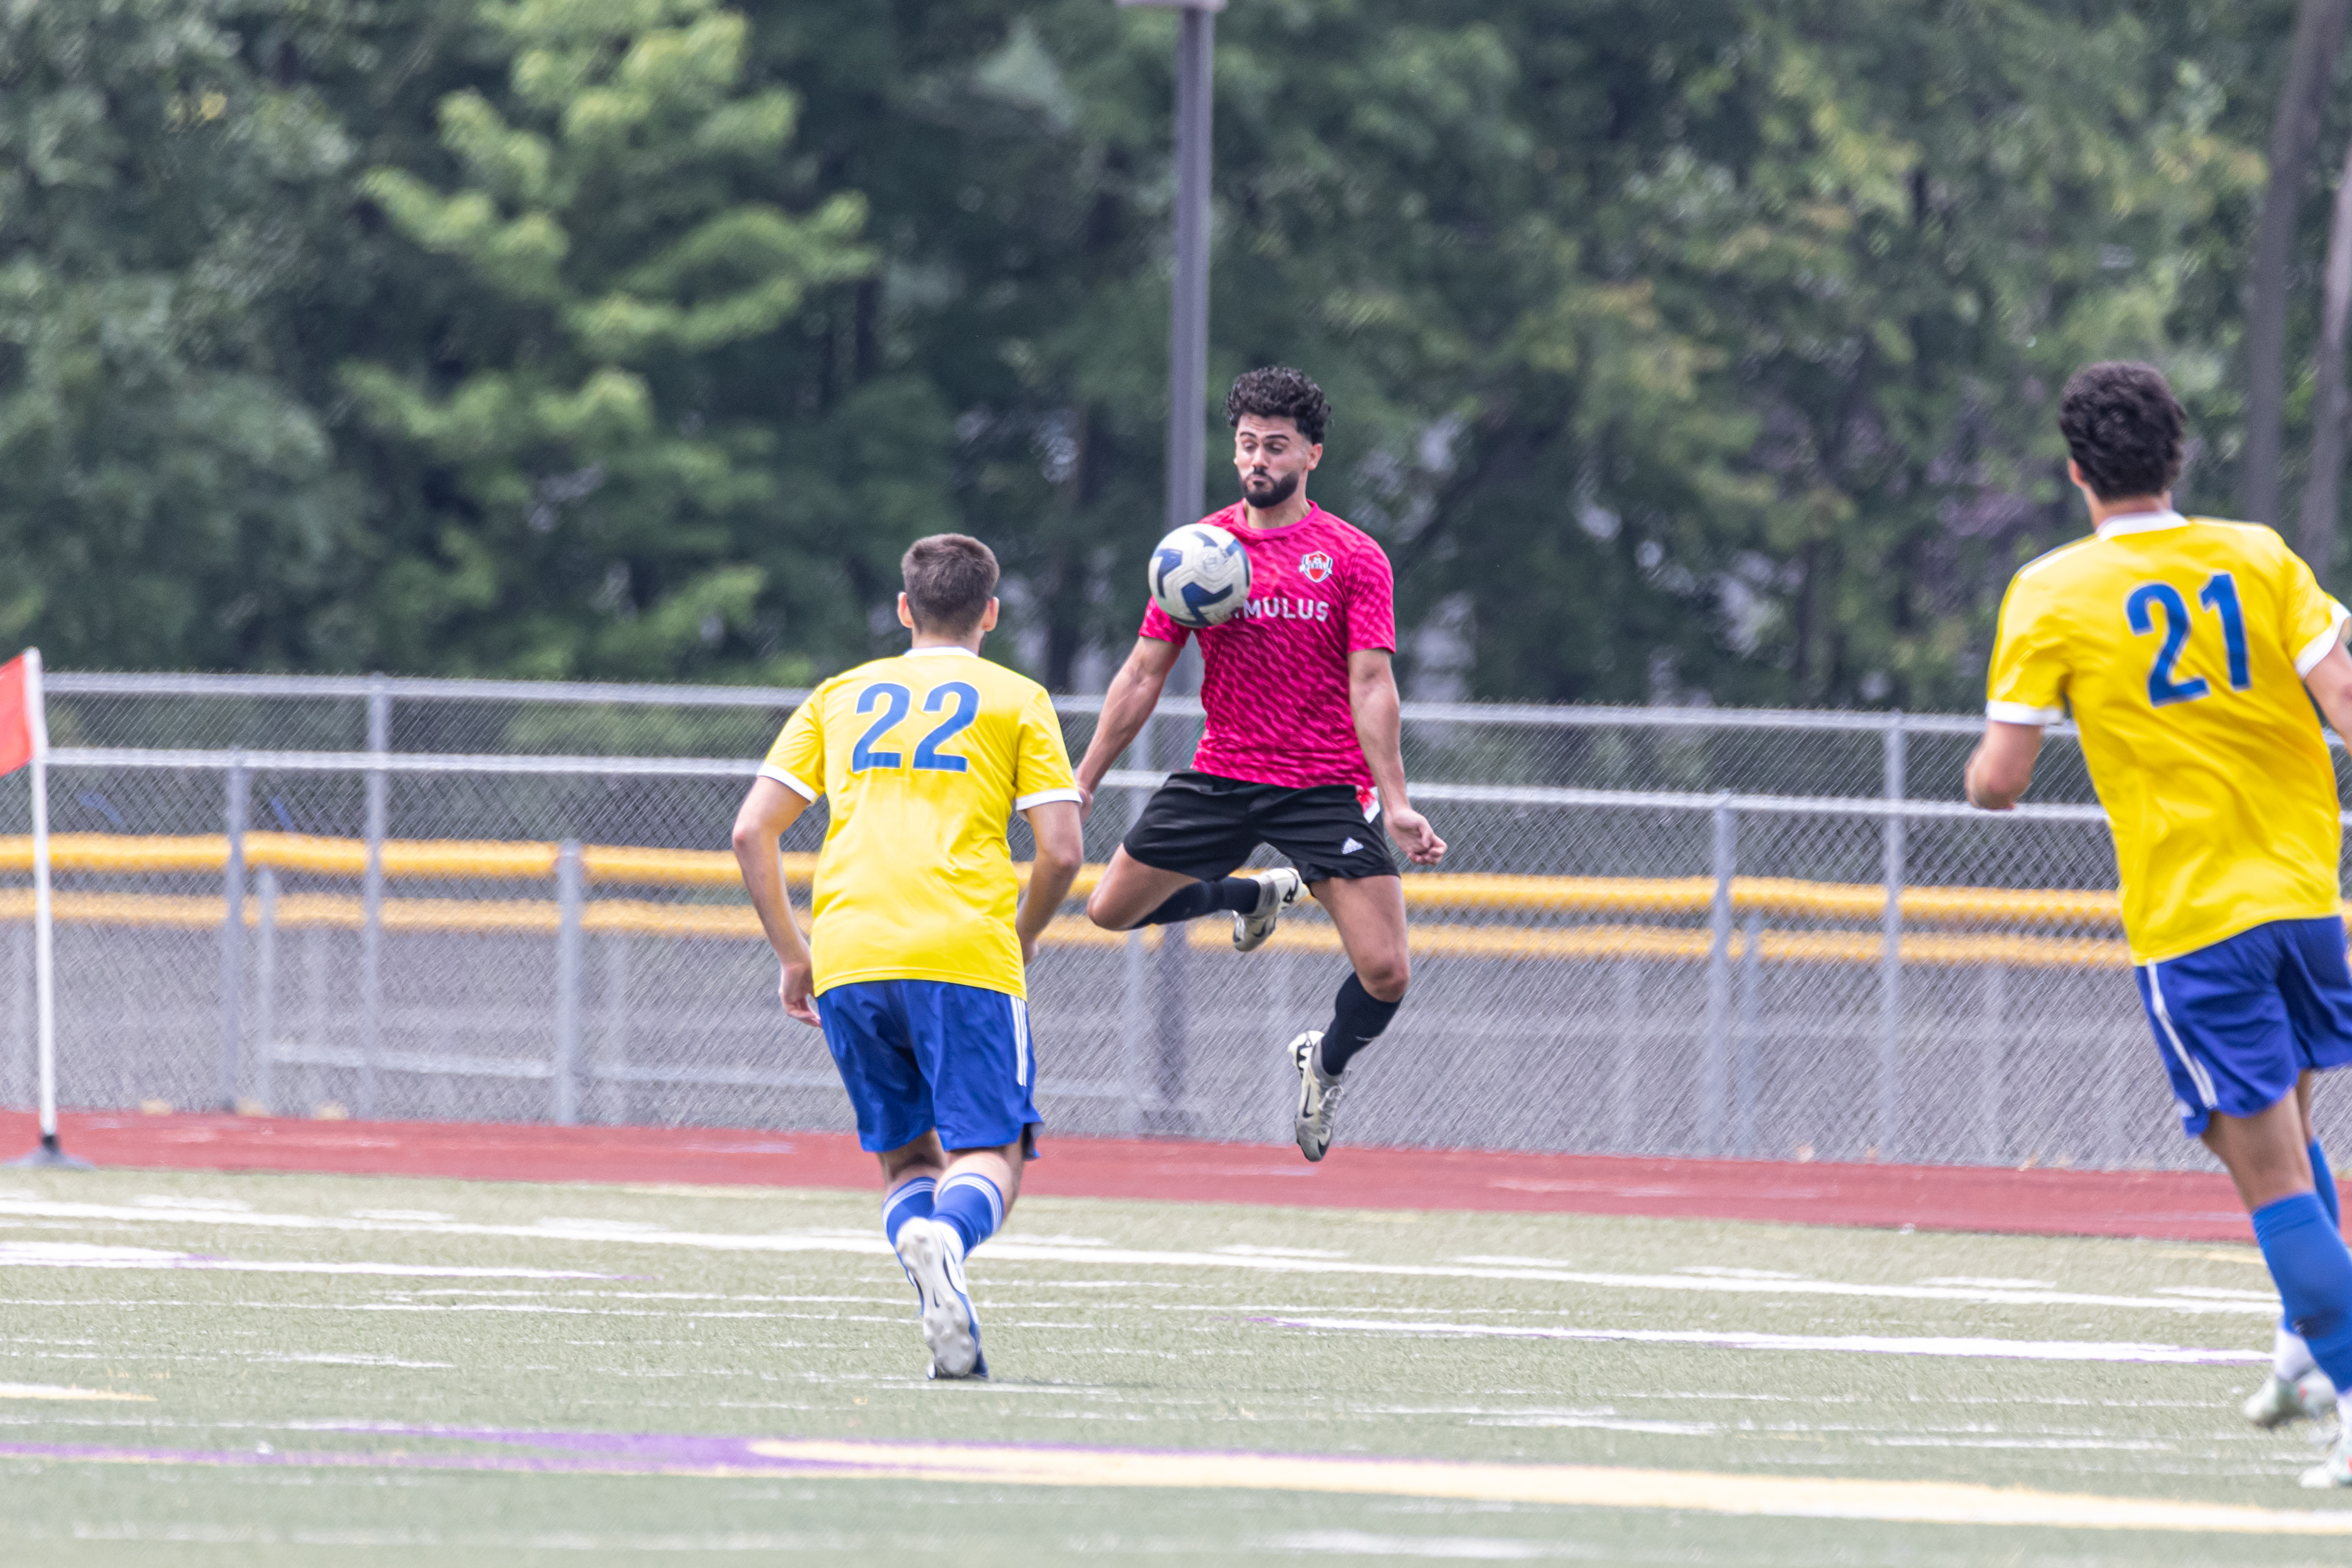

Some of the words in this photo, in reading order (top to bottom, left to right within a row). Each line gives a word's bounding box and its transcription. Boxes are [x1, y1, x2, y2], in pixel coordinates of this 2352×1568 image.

[1234, 597, 1329, 622] MULUS
[2123, 570, 2252, 709] 21
[853, 682, 980, 773] 22
